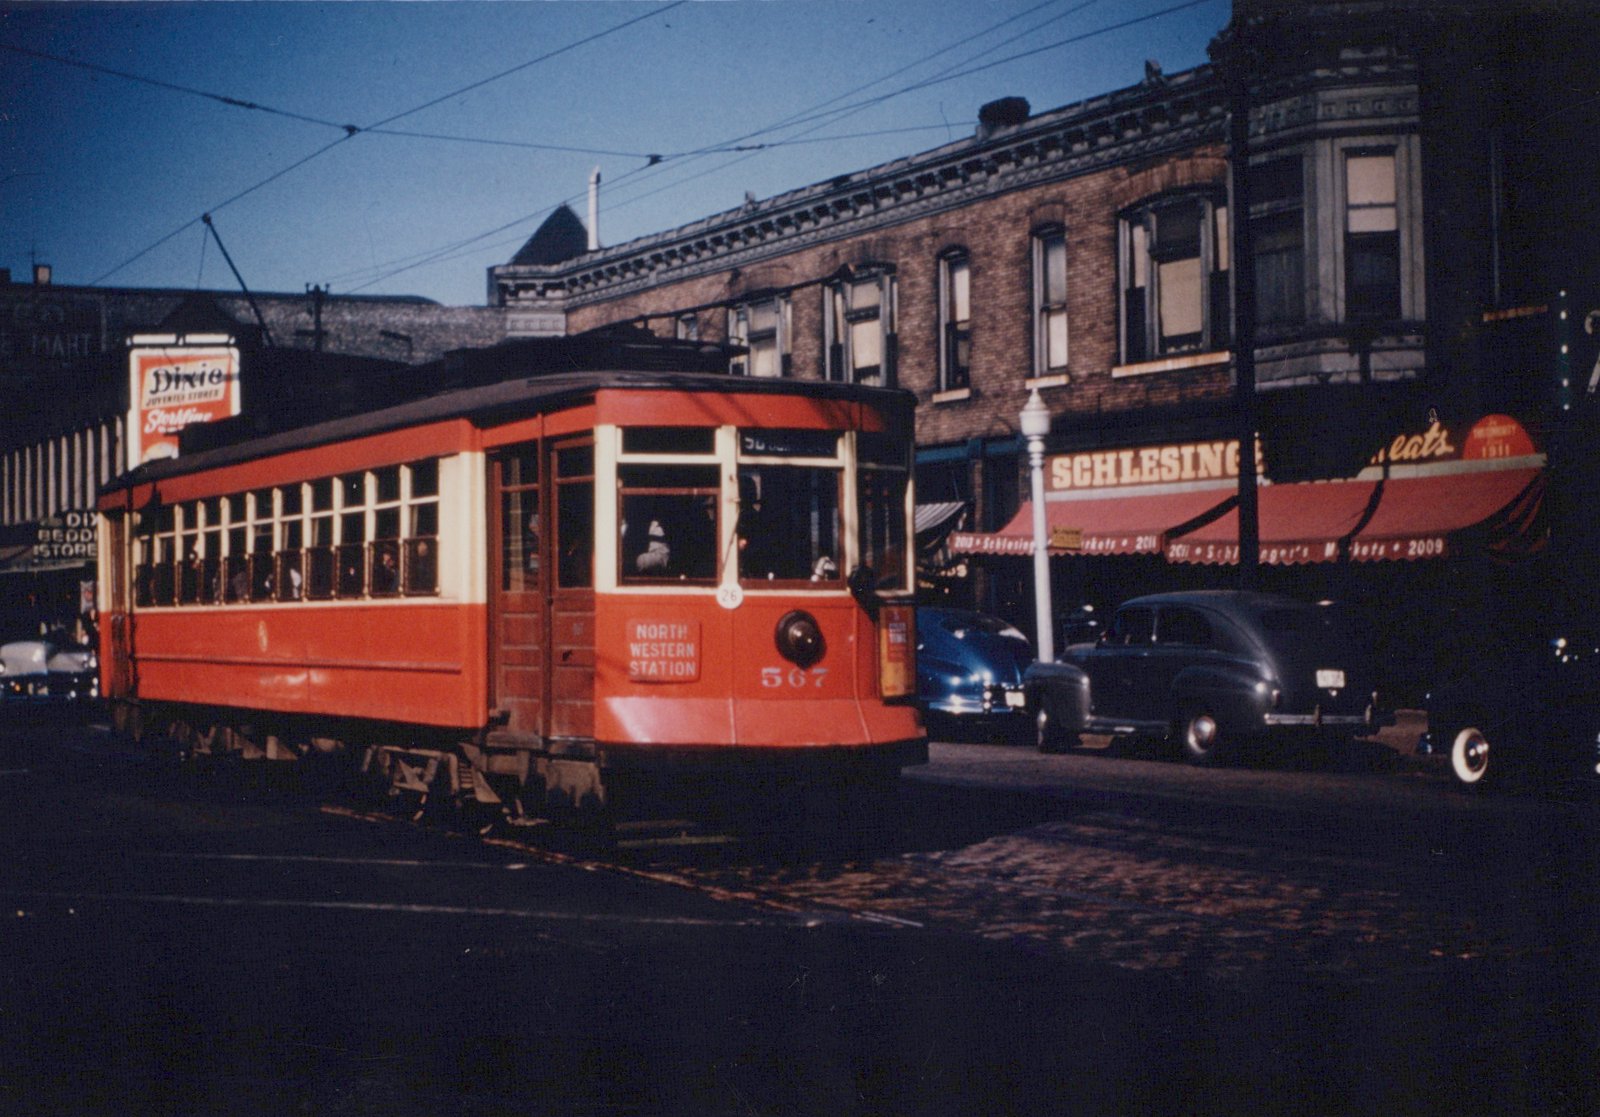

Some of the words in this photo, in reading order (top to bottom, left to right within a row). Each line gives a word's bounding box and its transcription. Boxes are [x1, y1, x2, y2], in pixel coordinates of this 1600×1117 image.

[149, 363, 222, 394] Dixie
[1407, 538, 1443, 556] 2009
[722, 588, 738, 602] 26
[636, 624, 688, 640] NORTH
[630, 642, 695, 658] WESTERN
[630, 660, 696, 677] STATION
[761, 667, 829, 688] 567
